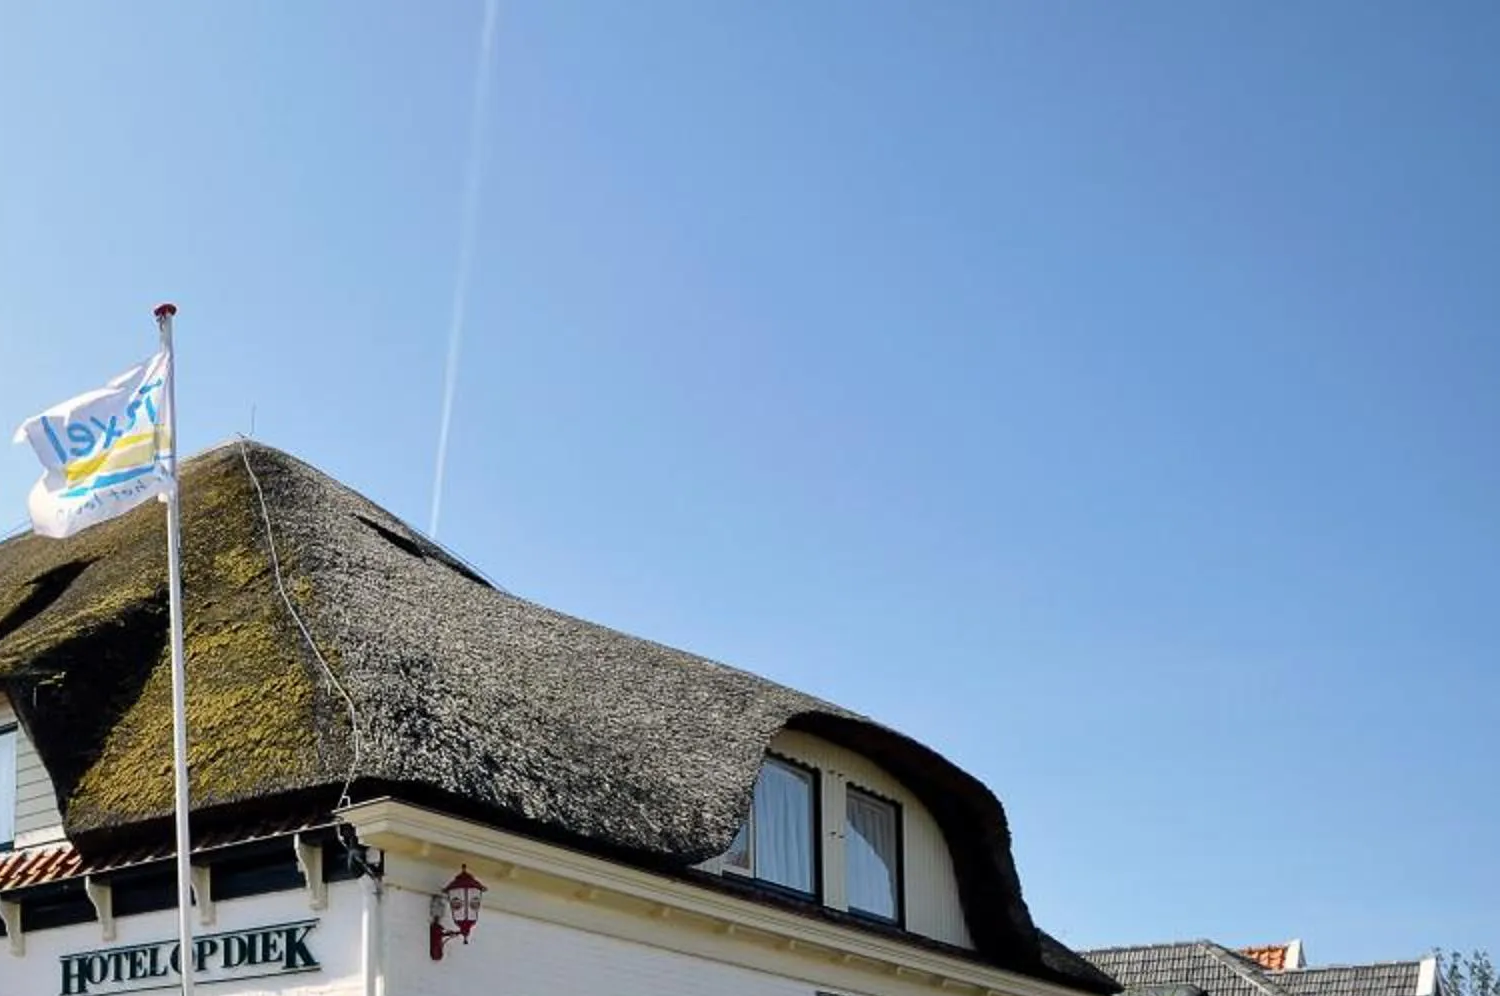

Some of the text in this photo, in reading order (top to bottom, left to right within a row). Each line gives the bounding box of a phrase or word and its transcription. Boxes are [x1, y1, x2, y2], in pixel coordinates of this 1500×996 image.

[60, 924, 320, 996] HOTEL OP DIEK
